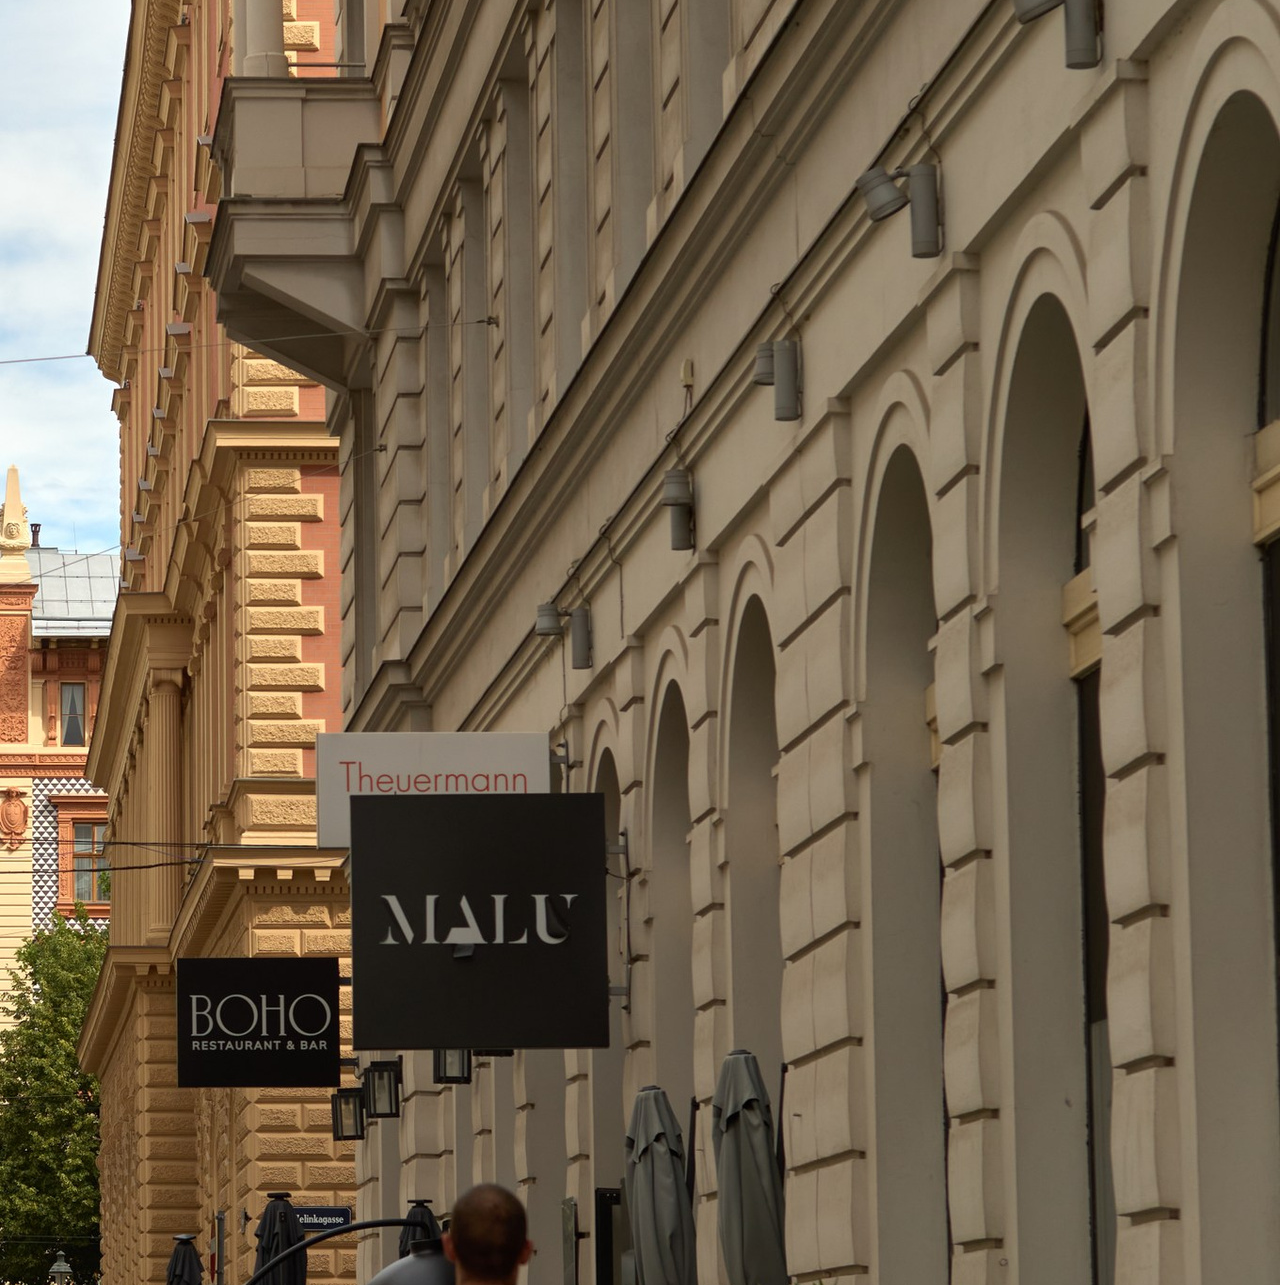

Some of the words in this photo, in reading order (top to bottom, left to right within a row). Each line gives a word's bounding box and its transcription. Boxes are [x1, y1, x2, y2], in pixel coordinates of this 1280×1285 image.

[339, 761, 528, 794] Theuermann
[379, 894, 579, 945] MALU
[189, 994, 331, 1036] BOHO
[192, 1041, 281, 1050] RESTAURANT
[286, 1041, 295, 1050] &
[300, 1041, 327, 1050] BAR
[296, 1214, 344, 1225] elinkagasse
